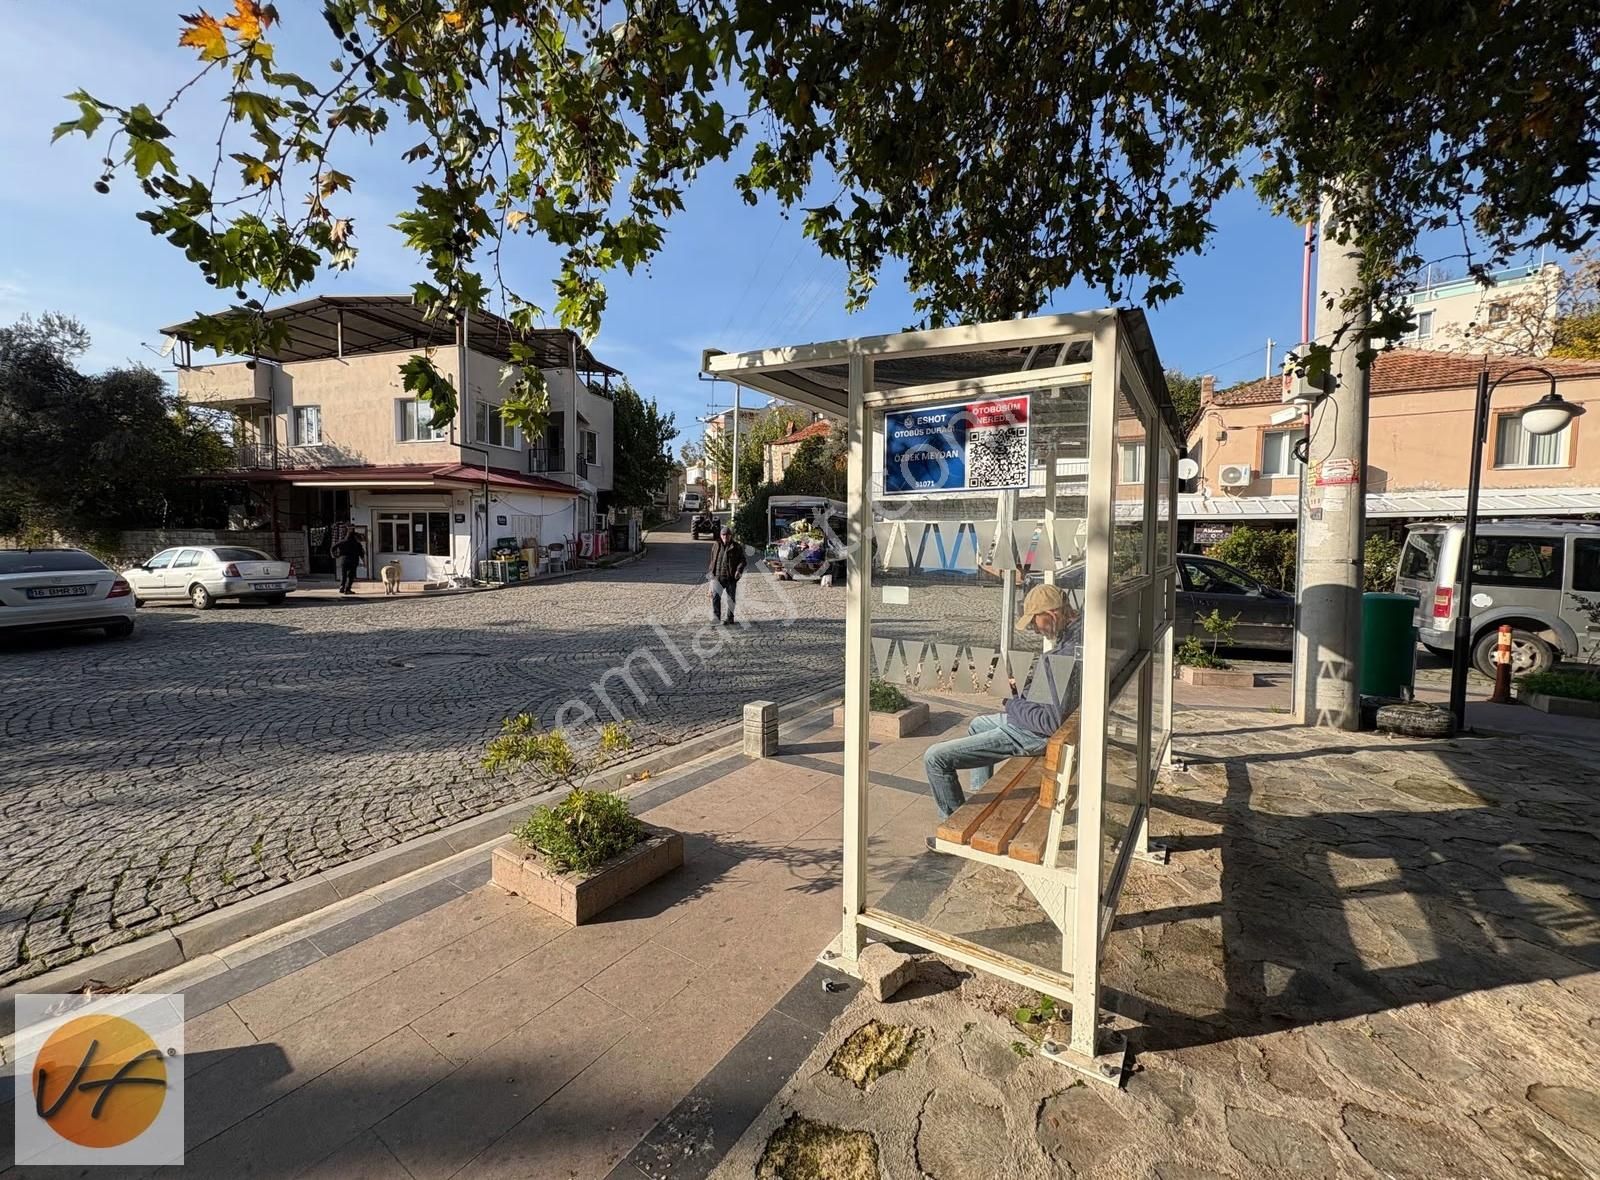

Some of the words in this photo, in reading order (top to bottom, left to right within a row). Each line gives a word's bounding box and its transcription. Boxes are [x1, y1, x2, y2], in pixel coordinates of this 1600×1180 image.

[917, 414, 947, 425] ESHOT
[894, 427, 924, 438] OTOBÜS
[921, 450, 959, 461] MEYDAN
